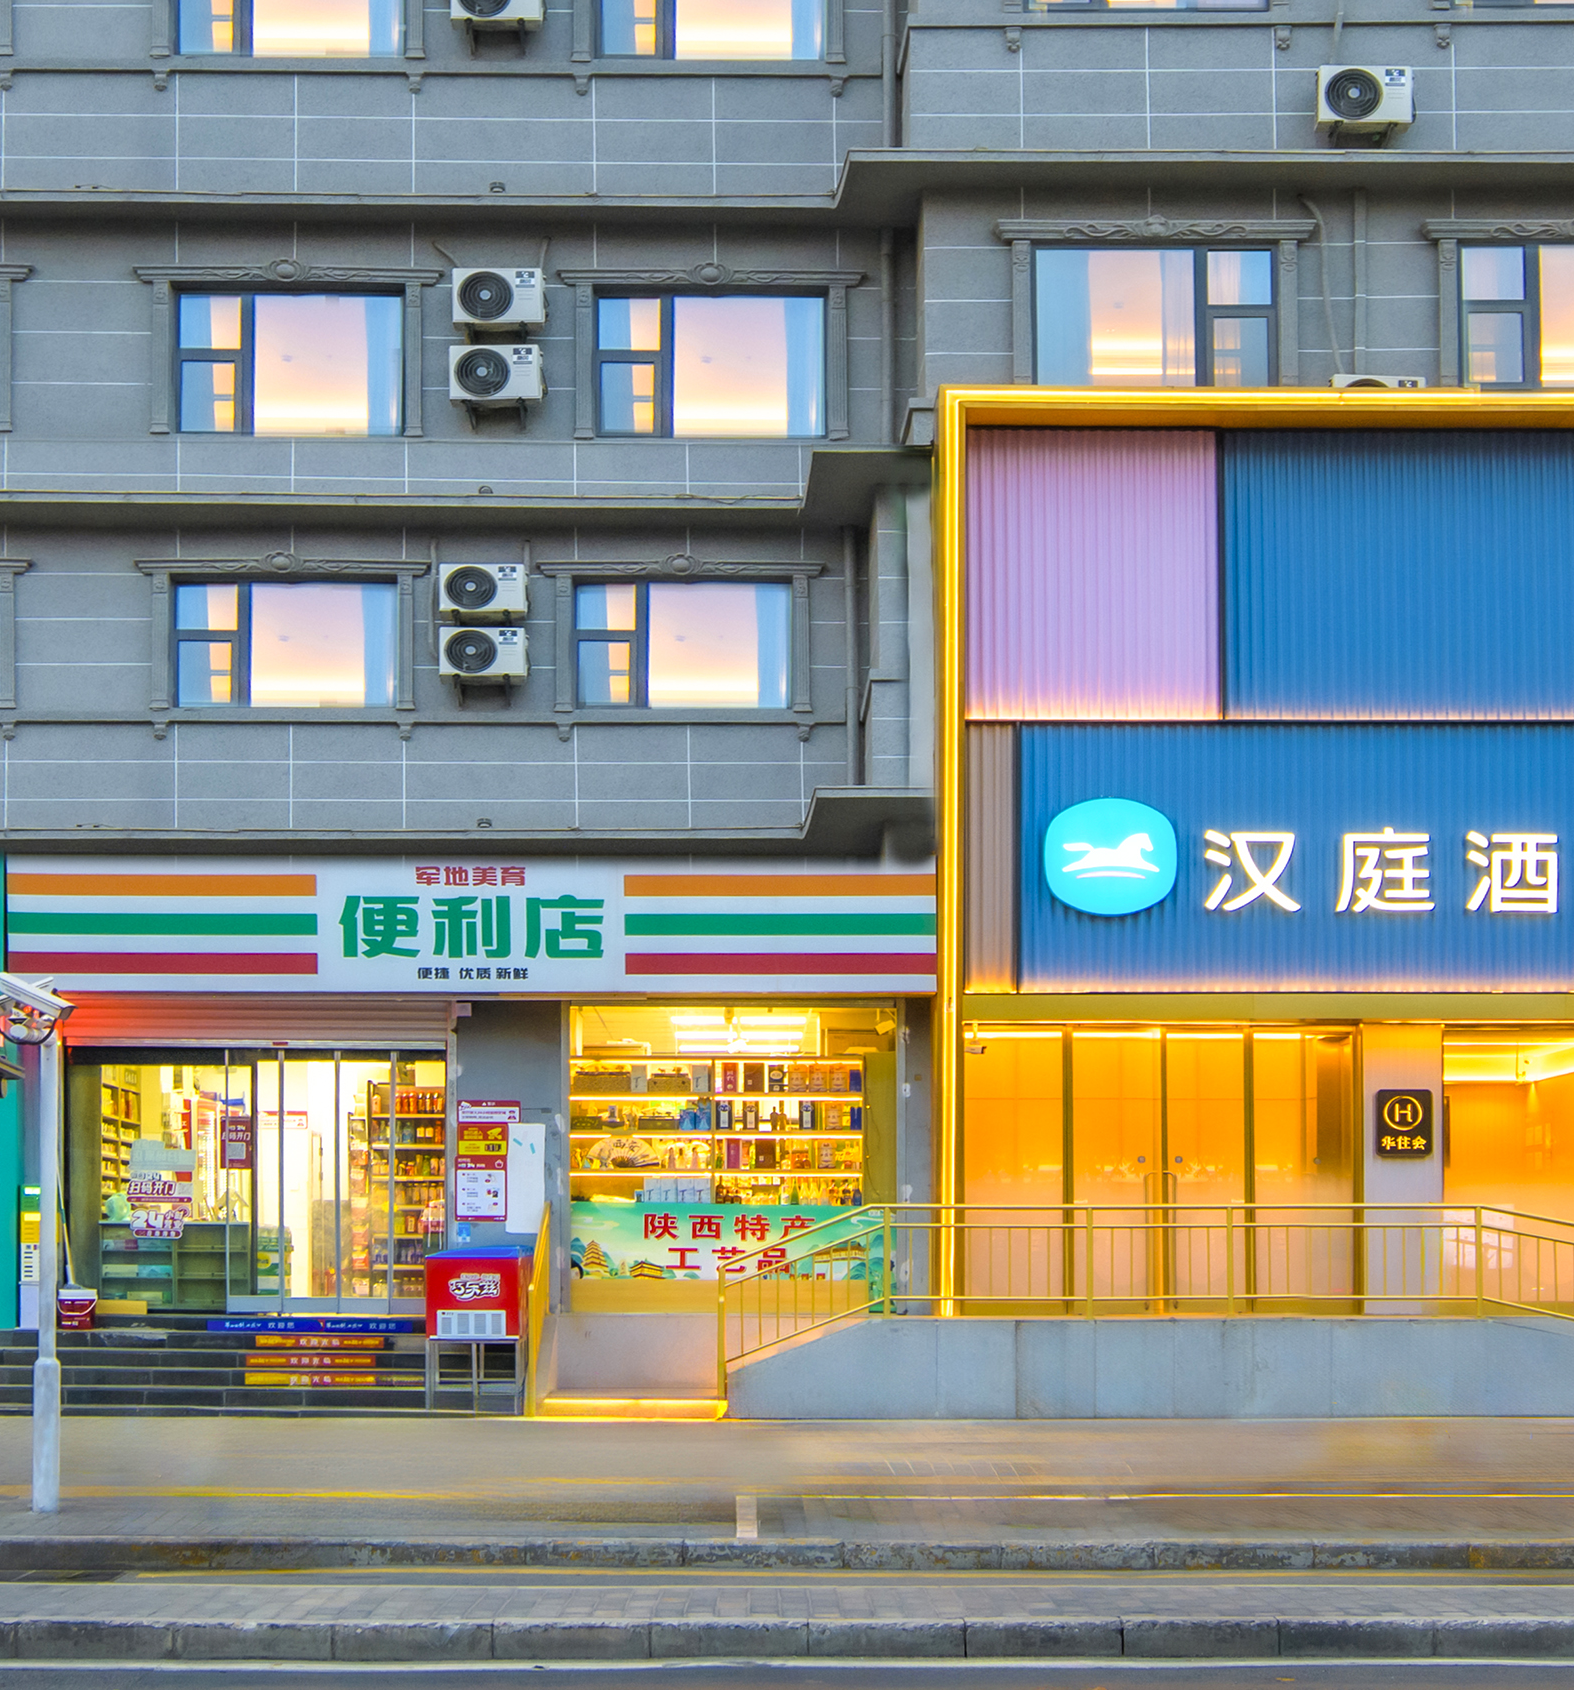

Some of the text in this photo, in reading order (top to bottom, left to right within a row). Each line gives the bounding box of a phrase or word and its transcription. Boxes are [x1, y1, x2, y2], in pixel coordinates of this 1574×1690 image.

[416, 866, 527, 887] 军地美育
[338, 894, 606, 960] 便利店
[417, 968, 529, 980] 便捷 优质 新鲜
[1381, 1135, 1427, 1151] 华住会
[128, 1181, 176, 1195] 扫码开门
[132, 1210, 165, 1229] 24
[643, 1213, 816, 1242] 陕西特产
[666, 1247, 791, 1274] 工艺品
[449, 1278, 500, 1301] 巧乐兹
